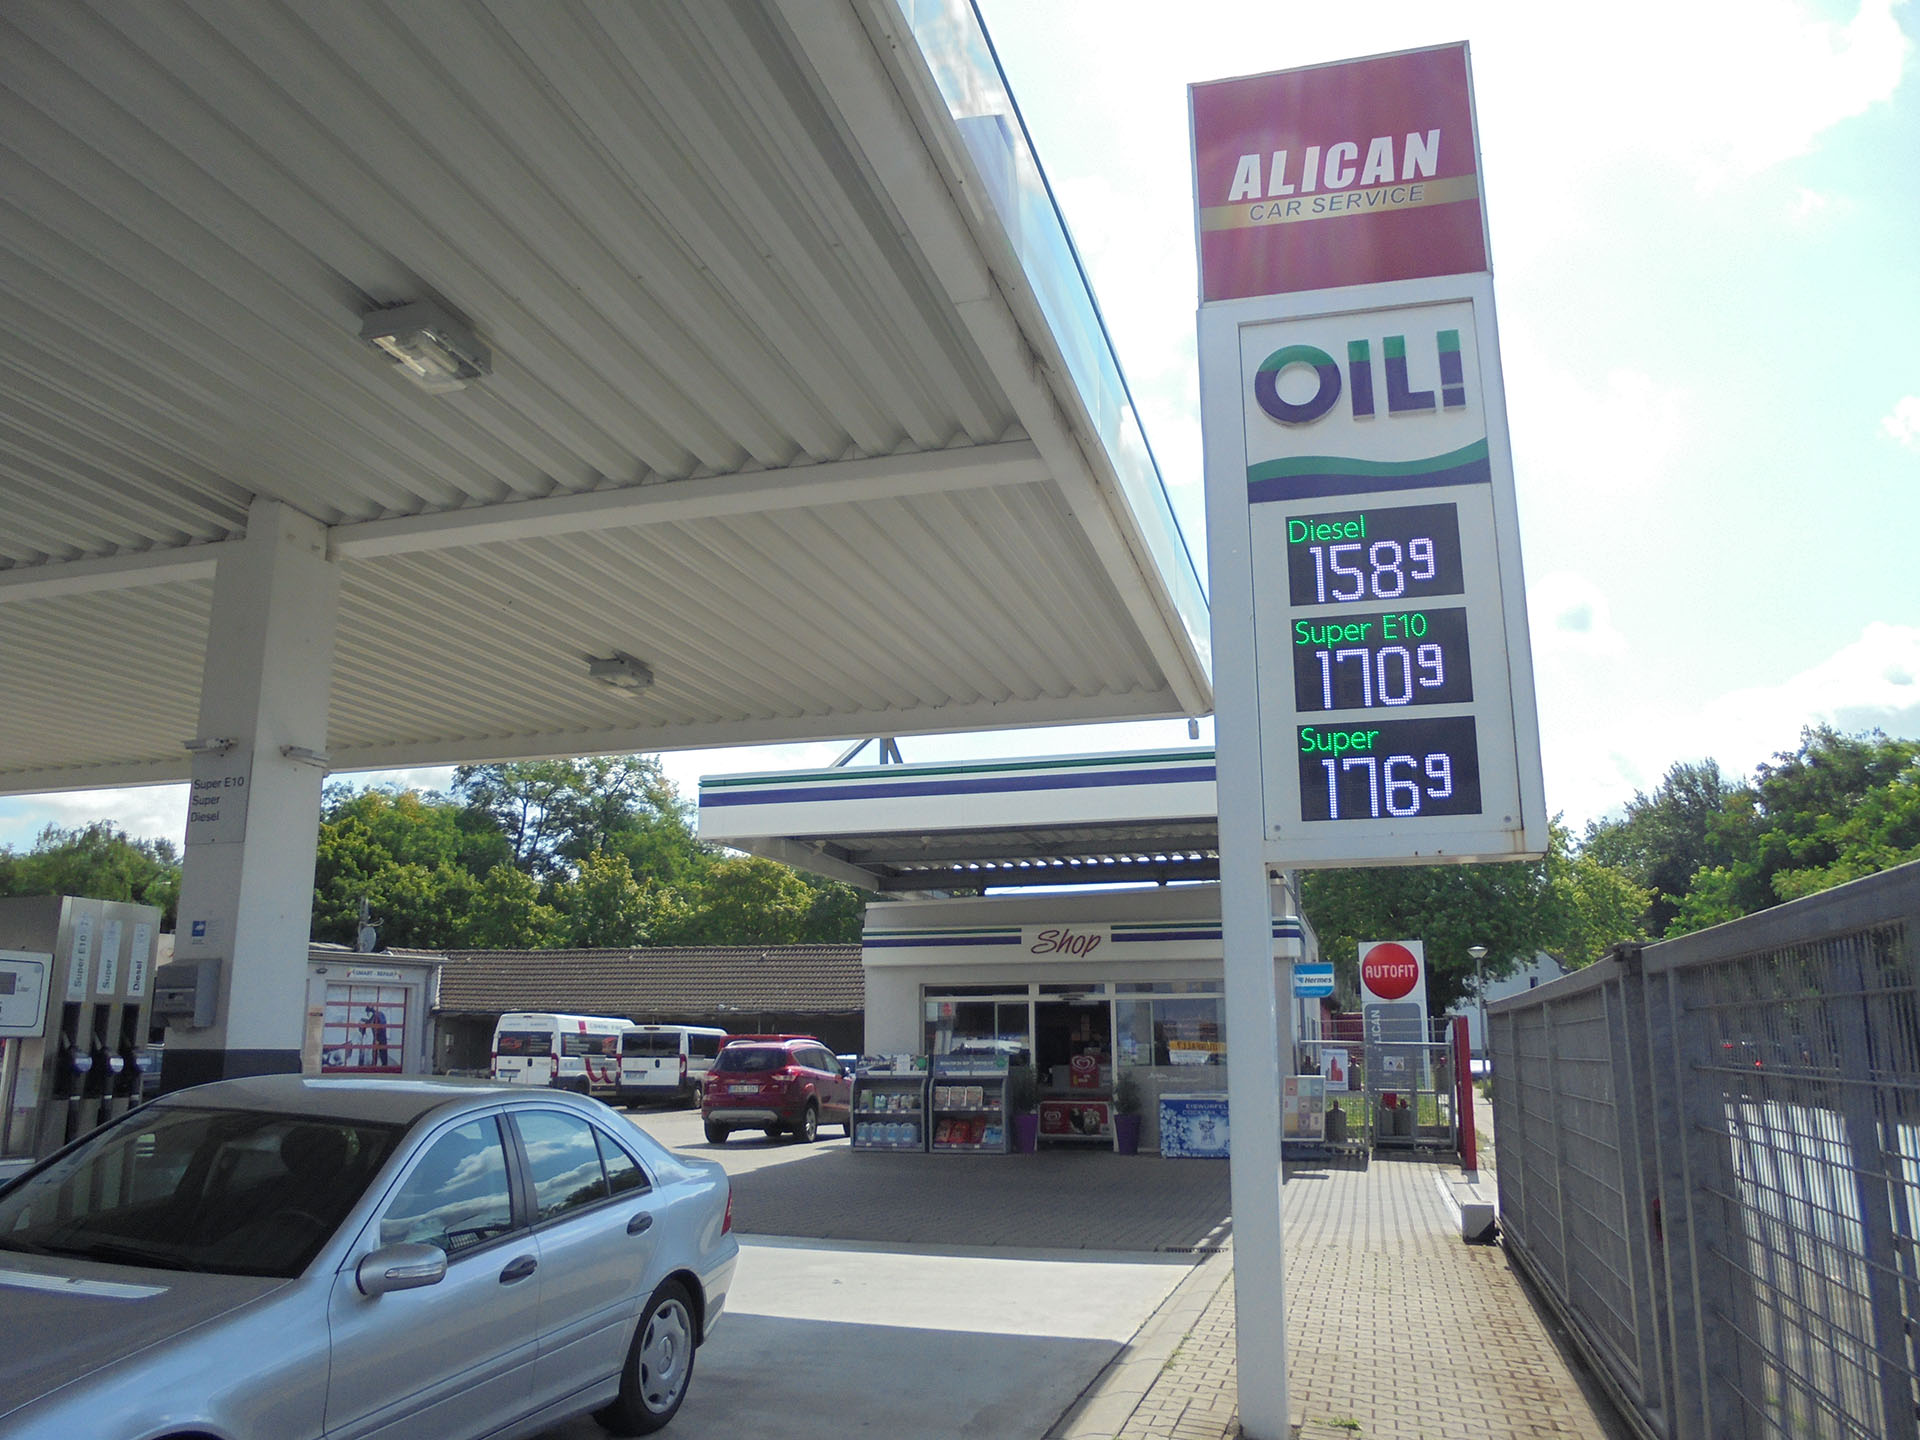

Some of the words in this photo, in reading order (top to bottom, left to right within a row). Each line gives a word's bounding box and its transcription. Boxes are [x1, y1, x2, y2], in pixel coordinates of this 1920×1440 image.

[1227, 129, 1441, 202] ALICAN
[1249, 201, 1301, 221] CAR
[1312, 184, 1425, 214] SERVICE
[1288, 514, 1367, 543] Diesel
[1295, 621, 1372, 649] Super
[1382, 613, 1427, 640] E10
[1300, 728, 1379, 757] Super
[193, 779, 222, 790] Super
[224, 776, 245, 788] E10
[192, 795, 220, 807] Super
[190, 811, 220, 823] Diesel
[78, 934, 87, 955] E10
[1030, 928, 1102, 958] Shop
[73, 958, 85, 988] Super
[102, 959, 113, 989] Super
[132, 960, 144, 991] Diesel
[1304, 976, 1333, 984] Hermes
[1365, 964, 1416, 980] AUTOFIT
[1370, 1009, 1382, 1052] LICAN
